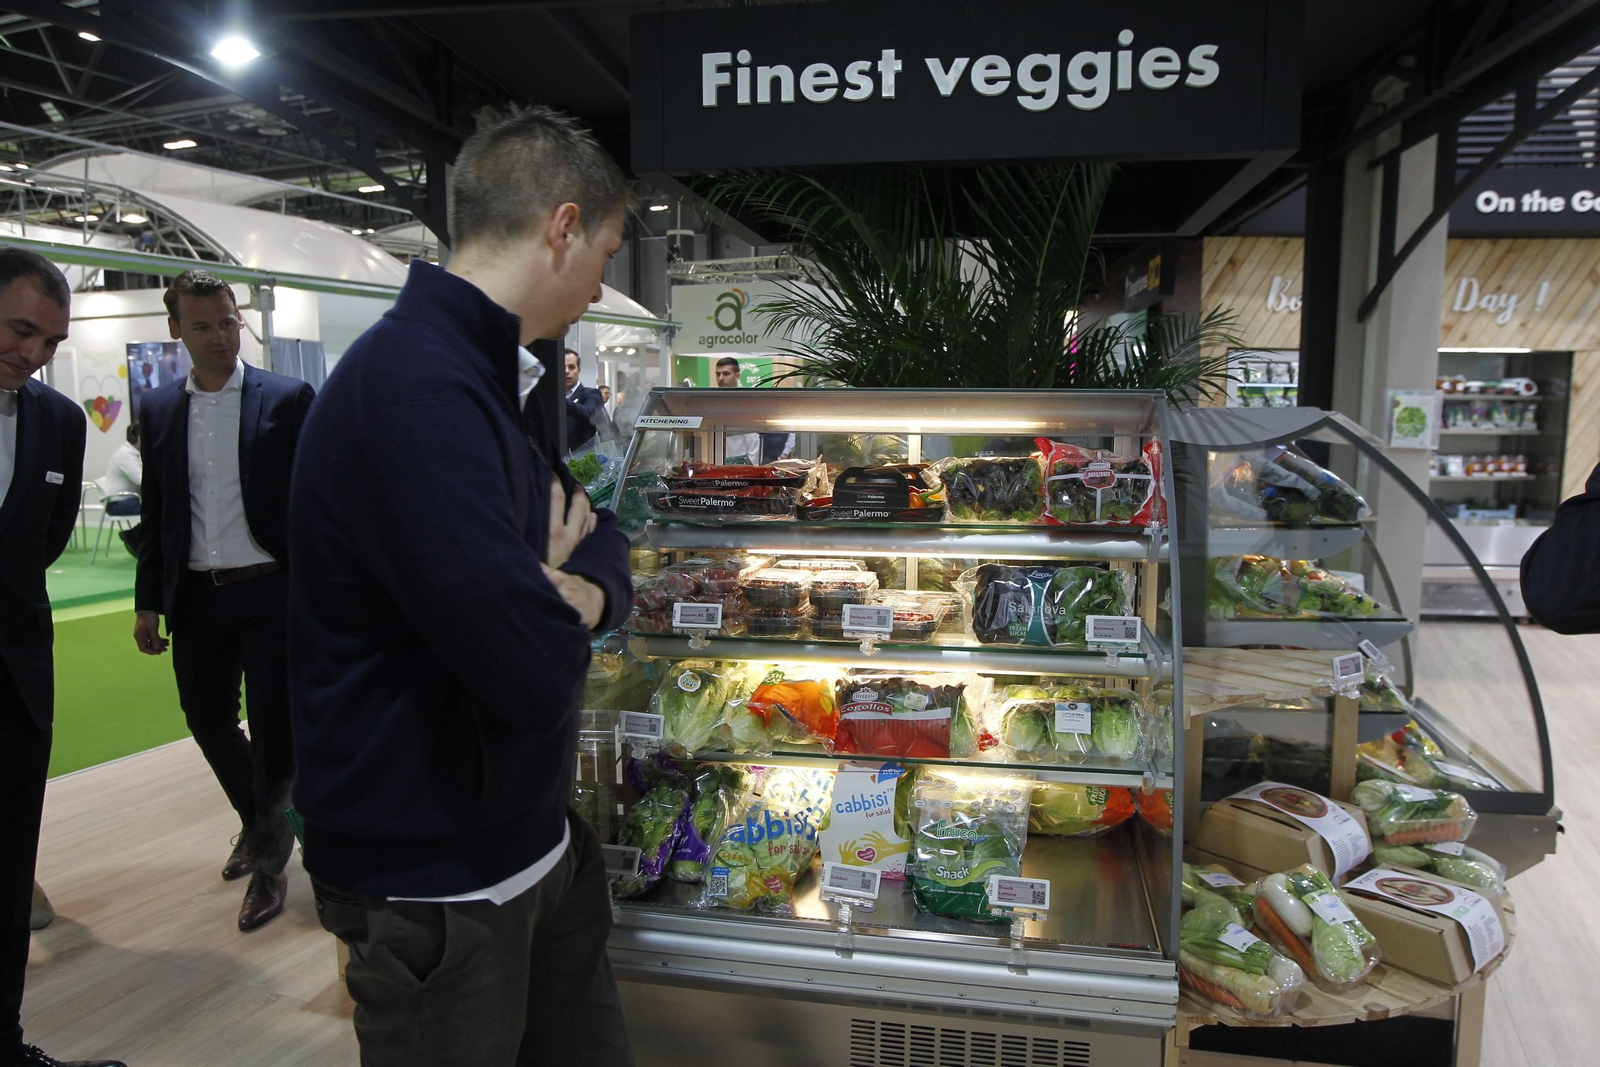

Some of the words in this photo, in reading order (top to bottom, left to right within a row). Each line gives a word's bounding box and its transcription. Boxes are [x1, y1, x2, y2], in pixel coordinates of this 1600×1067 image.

[702, 49, 902, 107] Finest
[925, 29, 1220, 111] veggies
[1475, 190, 1516, 213] On
[1521, 189, 1566, 212] the
[1453, 277, 1523, 325] Day
[699, 331, 759, 349] agrocolor
[1008, 601, 1066, 615] Salanova
[841, 703, 890, 713] Cogollos
[836, 791, 889, 814] cabbisi
[866, 810, 875, 819] for
[876, 807, 891, 817] salad
[768, 842, 785, 859] for
[936, 865, 970, 880] Snack
